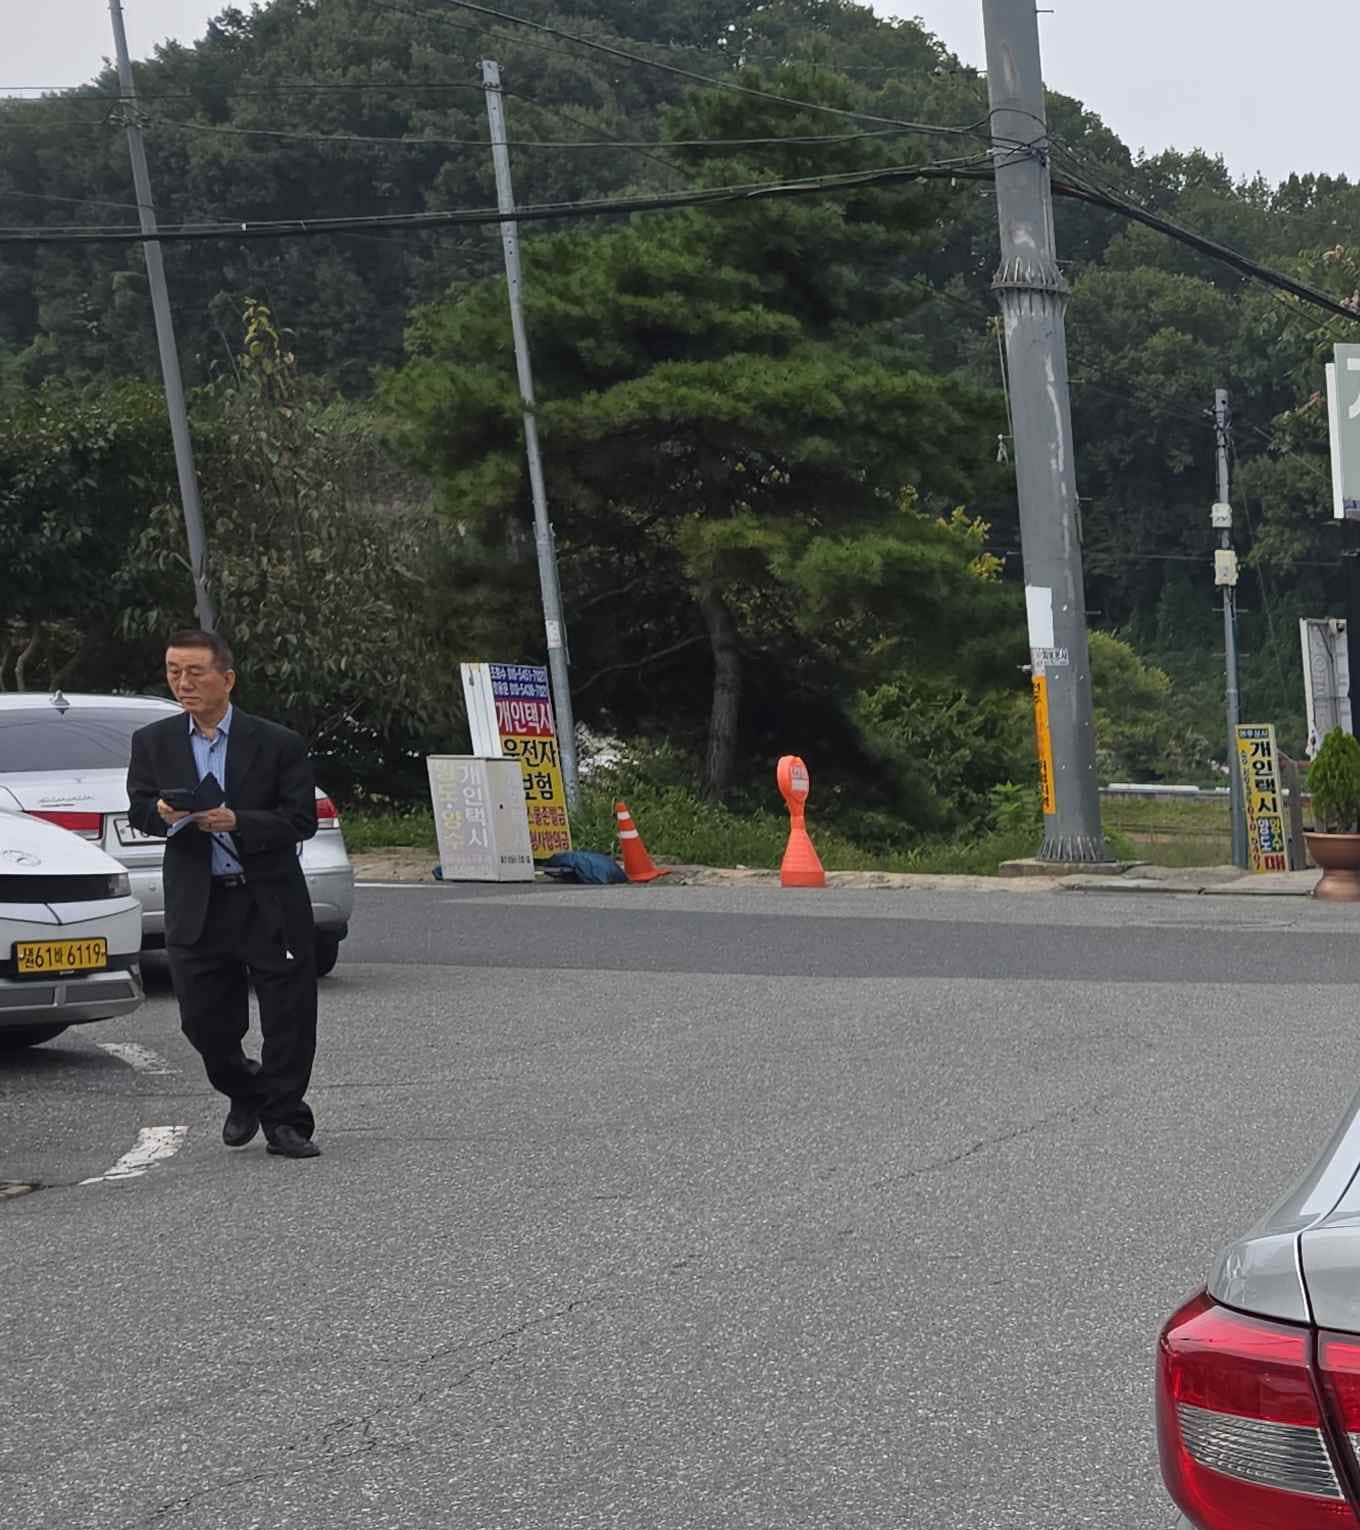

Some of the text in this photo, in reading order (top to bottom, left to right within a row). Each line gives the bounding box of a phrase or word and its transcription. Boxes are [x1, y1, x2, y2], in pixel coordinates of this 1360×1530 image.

[496, 701, 555, 734] 개인택시
[1250, 741, 1278, 813] 개인택시
[66, 943, 101, 966] 6119
